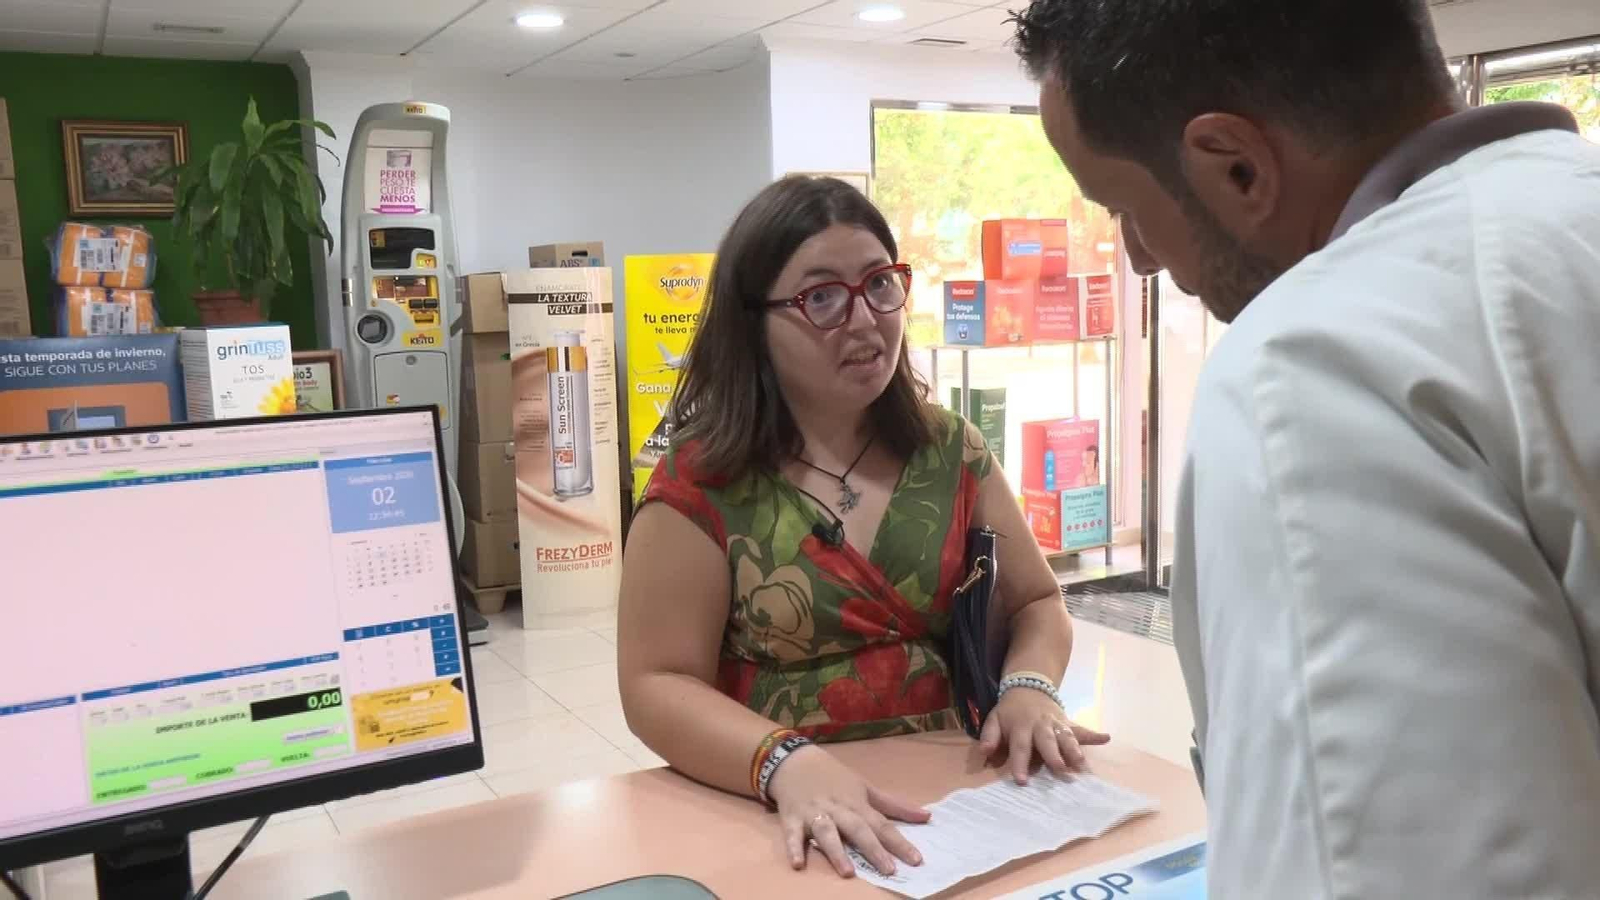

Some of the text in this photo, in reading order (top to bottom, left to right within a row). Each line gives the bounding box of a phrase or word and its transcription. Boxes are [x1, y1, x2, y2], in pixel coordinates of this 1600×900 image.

[380, 170, 416, 180] PERDER
[380, 187, 416, 195] CUESTA
[380, 195, 416, 203] MENOS
[660, 276, 704, 289] Supradyn
[538, 292, 593, 303] LA TEXTURA
[548, 304, 583, 314] VELVET
[643, 312, 657, 324] tu
[665, 326, 687, 334] lleva
[0, 346, 166, 364] sta temporada de invierno,
[4, 359, 158, 378] SIGUE CON TUS PLANES
[242, 365, 265, 375] TOS
[556, 376, 567, 435] Sun Screen
[372, 486, 396, 506] 02
[537, 561, 589, 573] Revoluciona
[591, 560, 600, 568] tu
[307, 690, 341, 710] 0,00
[156, 721, 193, 734] IMPORTE
[195, 719, 207, 728] DE
[208, 717, 219, 725] LA
